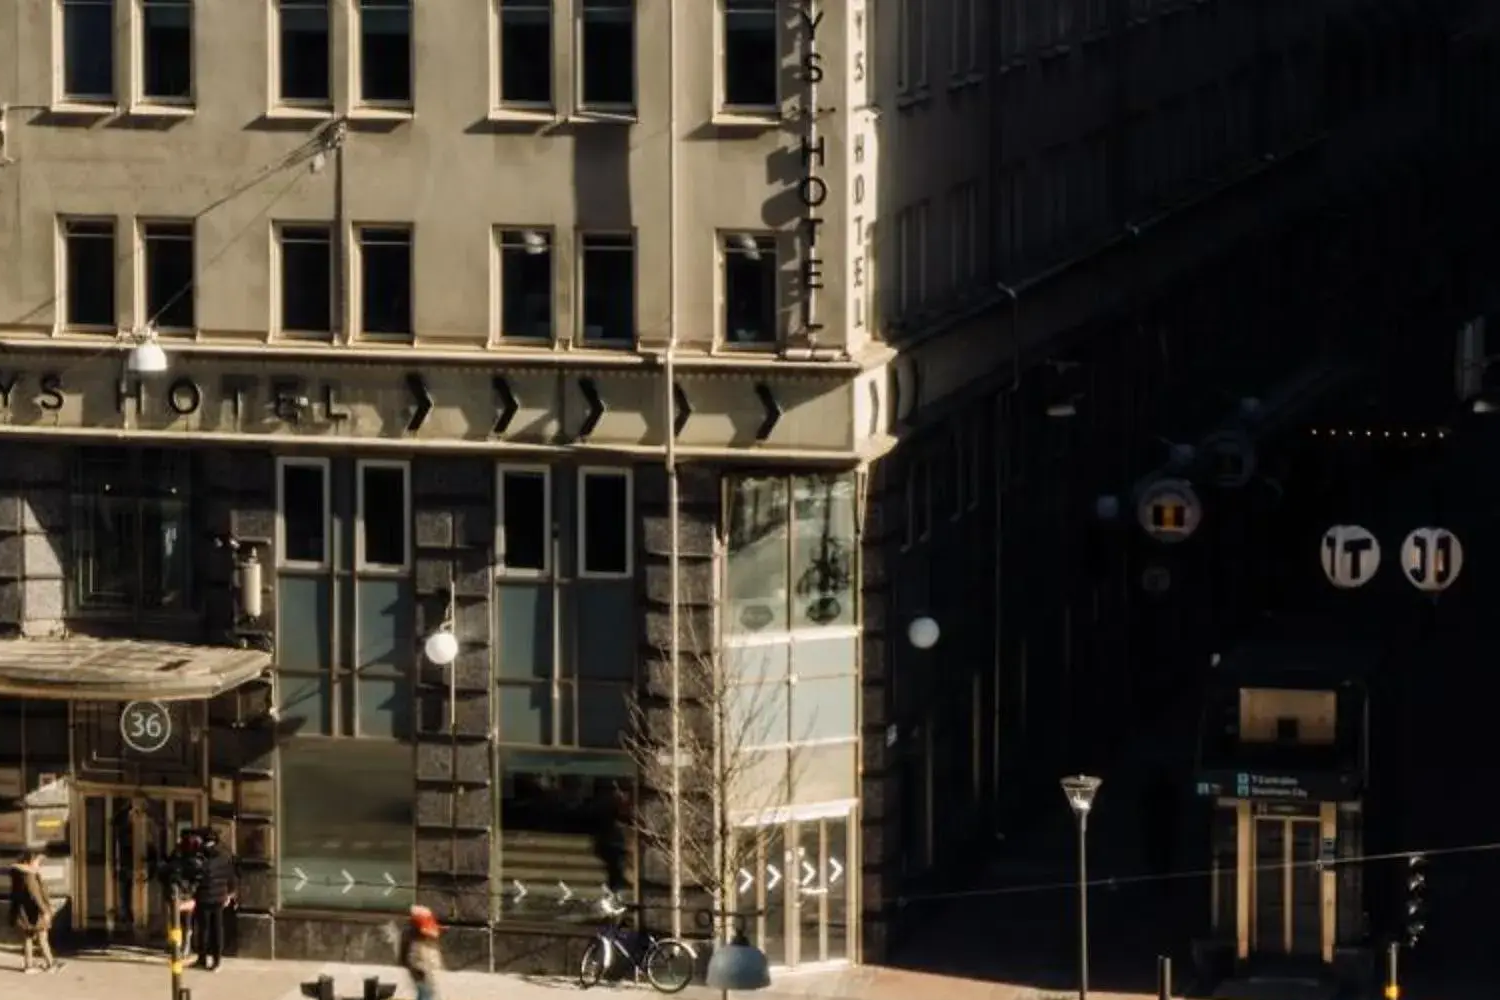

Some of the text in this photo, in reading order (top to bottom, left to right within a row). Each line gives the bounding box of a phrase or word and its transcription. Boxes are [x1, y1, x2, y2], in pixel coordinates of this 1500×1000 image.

[802, 136, 826, 330] HOTEL
[116, 373, 348, 420] HOTEL
[1342, 538, 1372, 579] T
[130, 712, 162, 737] 36
